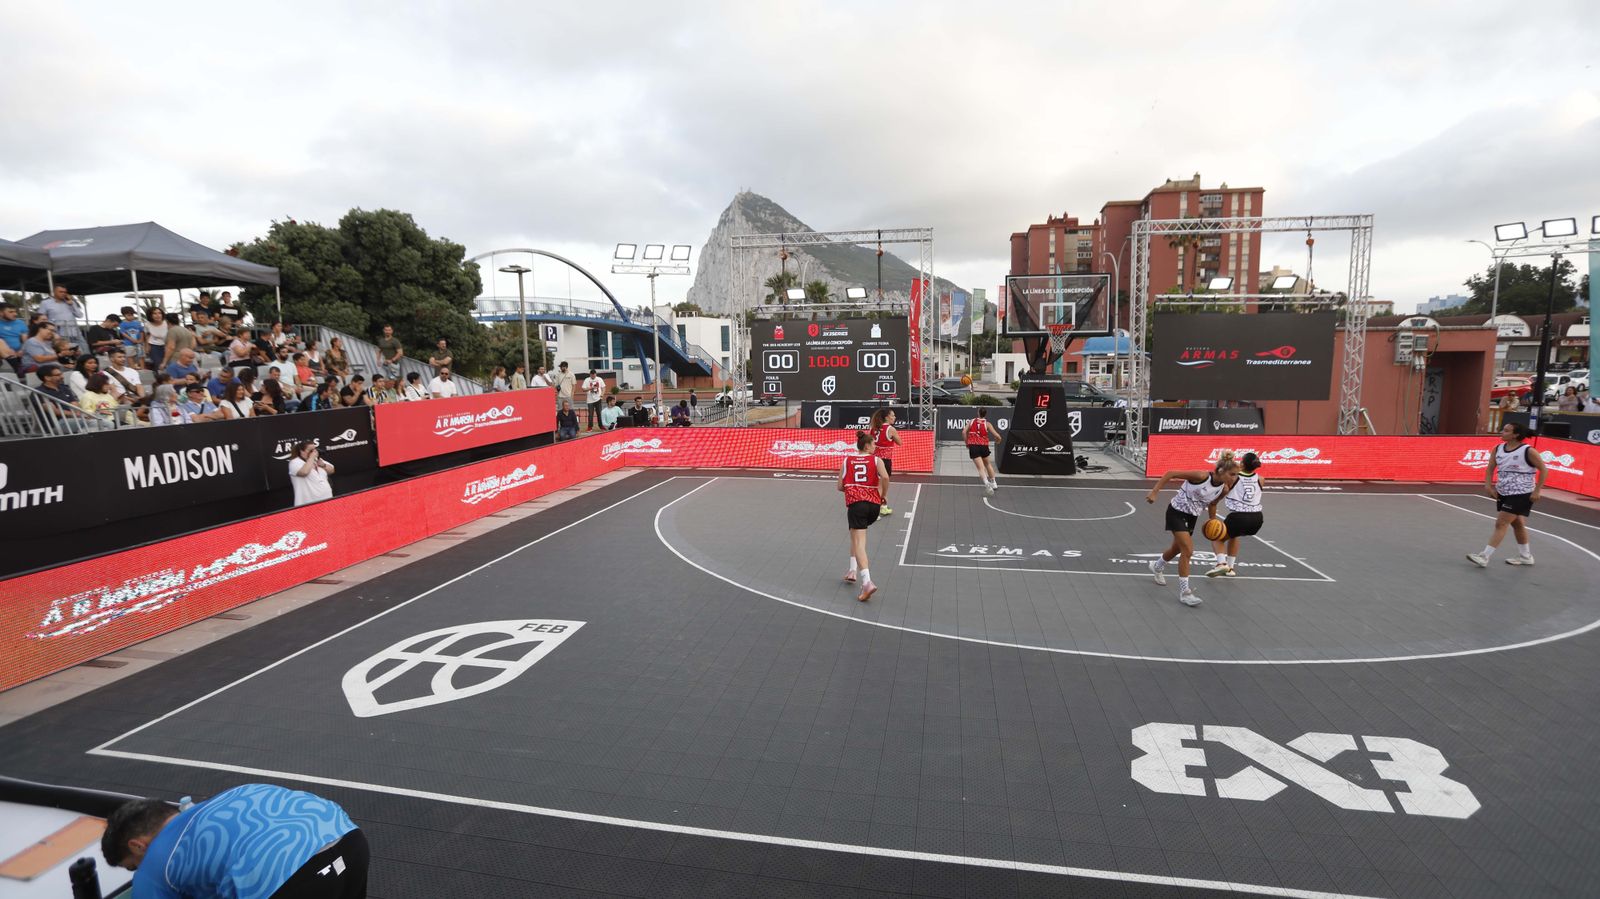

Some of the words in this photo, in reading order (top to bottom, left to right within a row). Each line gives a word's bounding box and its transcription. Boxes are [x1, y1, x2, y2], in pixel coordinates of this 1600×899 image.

[863, 353, 890, 368] 00
[1180, 350, 1239, 359] ARMAS
[769, 354, 793, 369] 00
[808, 355, 850, 368] 10:00
[769, 383, 776, 391] 0
[882, 383, 889, 391] 0
[1037, 394, 1050, 407] 12
[854, 464, 867, 482] 2
[937, 545, 1083, 557] ARMAS
[517, 622, 569, 634] FEB
